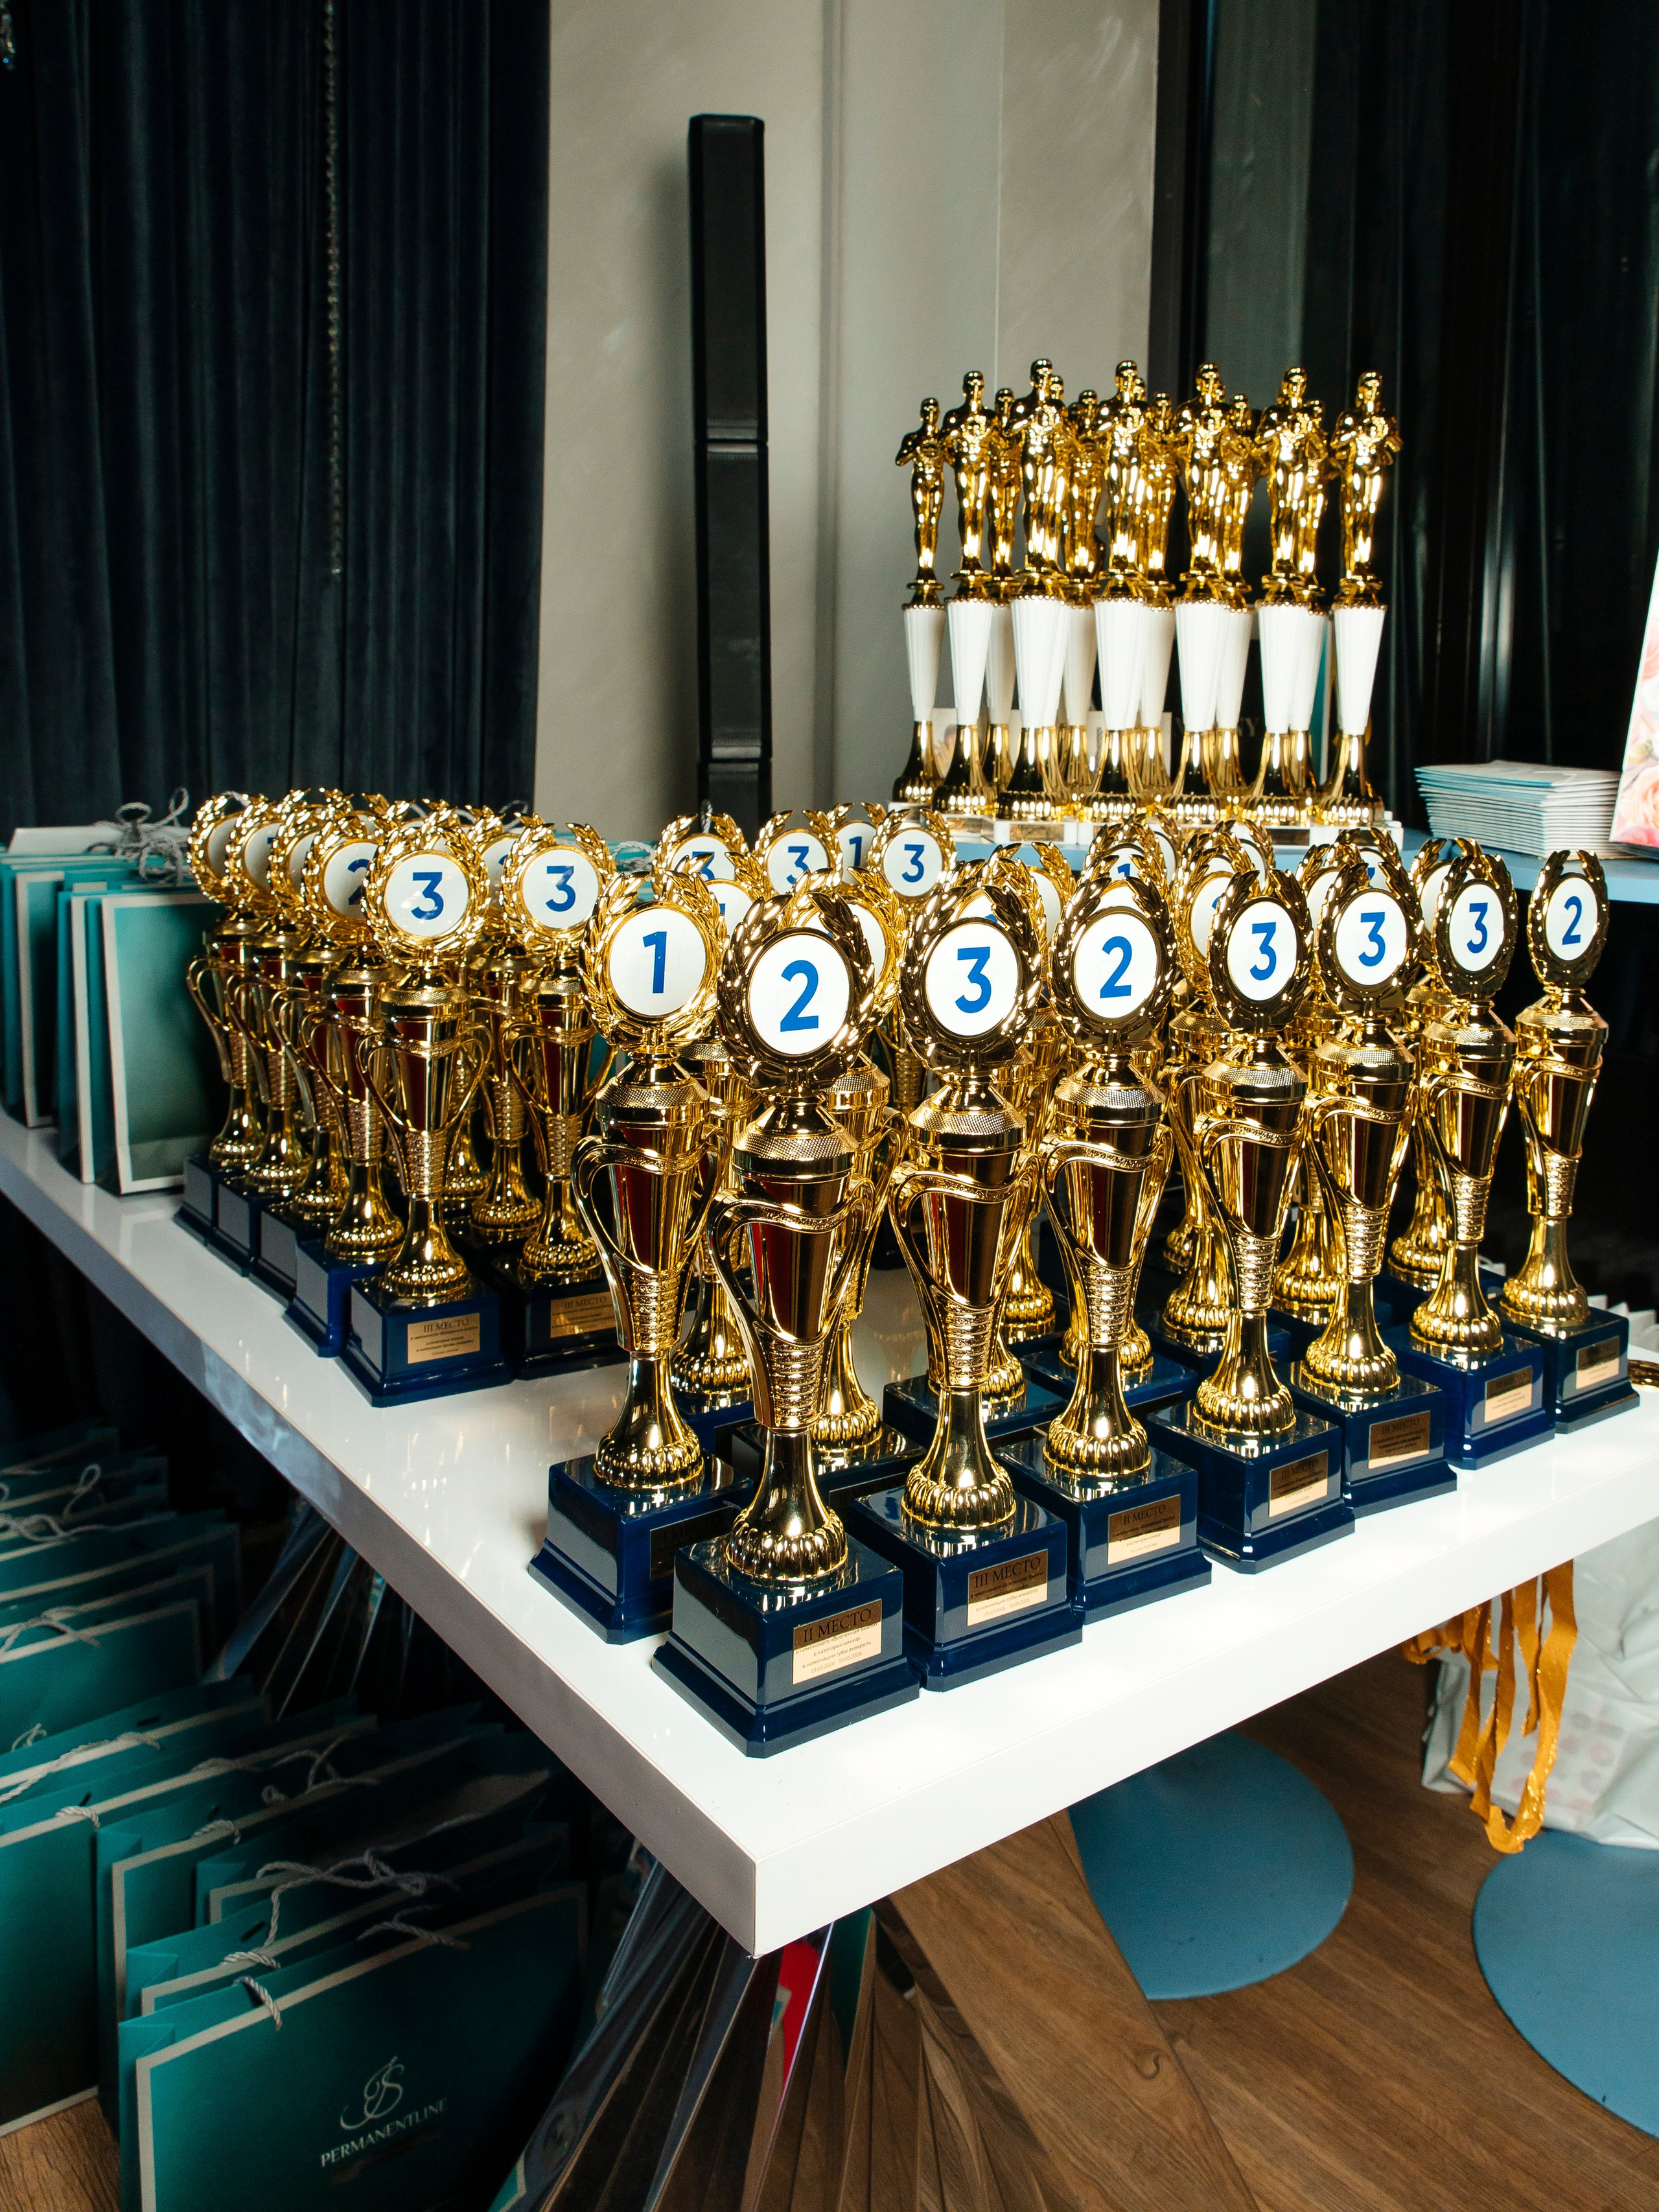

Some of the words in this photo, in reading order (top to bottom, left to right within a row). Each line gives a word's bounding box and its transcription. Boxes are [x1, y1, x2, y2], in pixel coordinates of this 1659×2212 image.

[786, 846, 809, 885] 3
[849, 836, 863, 867] 1
[902, 844, 925, 883] 3
[411, 872, 444, 920] 3
[546, 865, 576, 912] 3
[1358, 911, 1386, 967] 3
[1467, 902, 1489, 954] 3
[1562, 896, 1581, 946] 2
[642, 931, 667, 994] 1
[1100, 936, 1132, 999] 2
[1249, 922, 1277, 981] 3
[780, 959, 819, 1032] 2
[955, 946, 992, 1014] 3
[436, 1318, 469, 1330] МЕСТО
[1124, 1515, 1130, 1525] II
[1132, 1504, 1166, 1522] МЕСТО
[975, 1572, 988, 1589] III
[993, 1556, 1041, 1583] МЕСТО
[800, 1640, 830, 1653] чемпионате
[804, 1628, 813, 1643] II
[818, 1608, 872, 1638] МЕСТО
[818, 1643, 842, 1655] категории
[844, 1636, 861, 1646] юниор
[807, 1654, 835, 1668] номинации
[836, 1649, 848, 1657] губы
[849, 1641, 871, 1652] акварель
